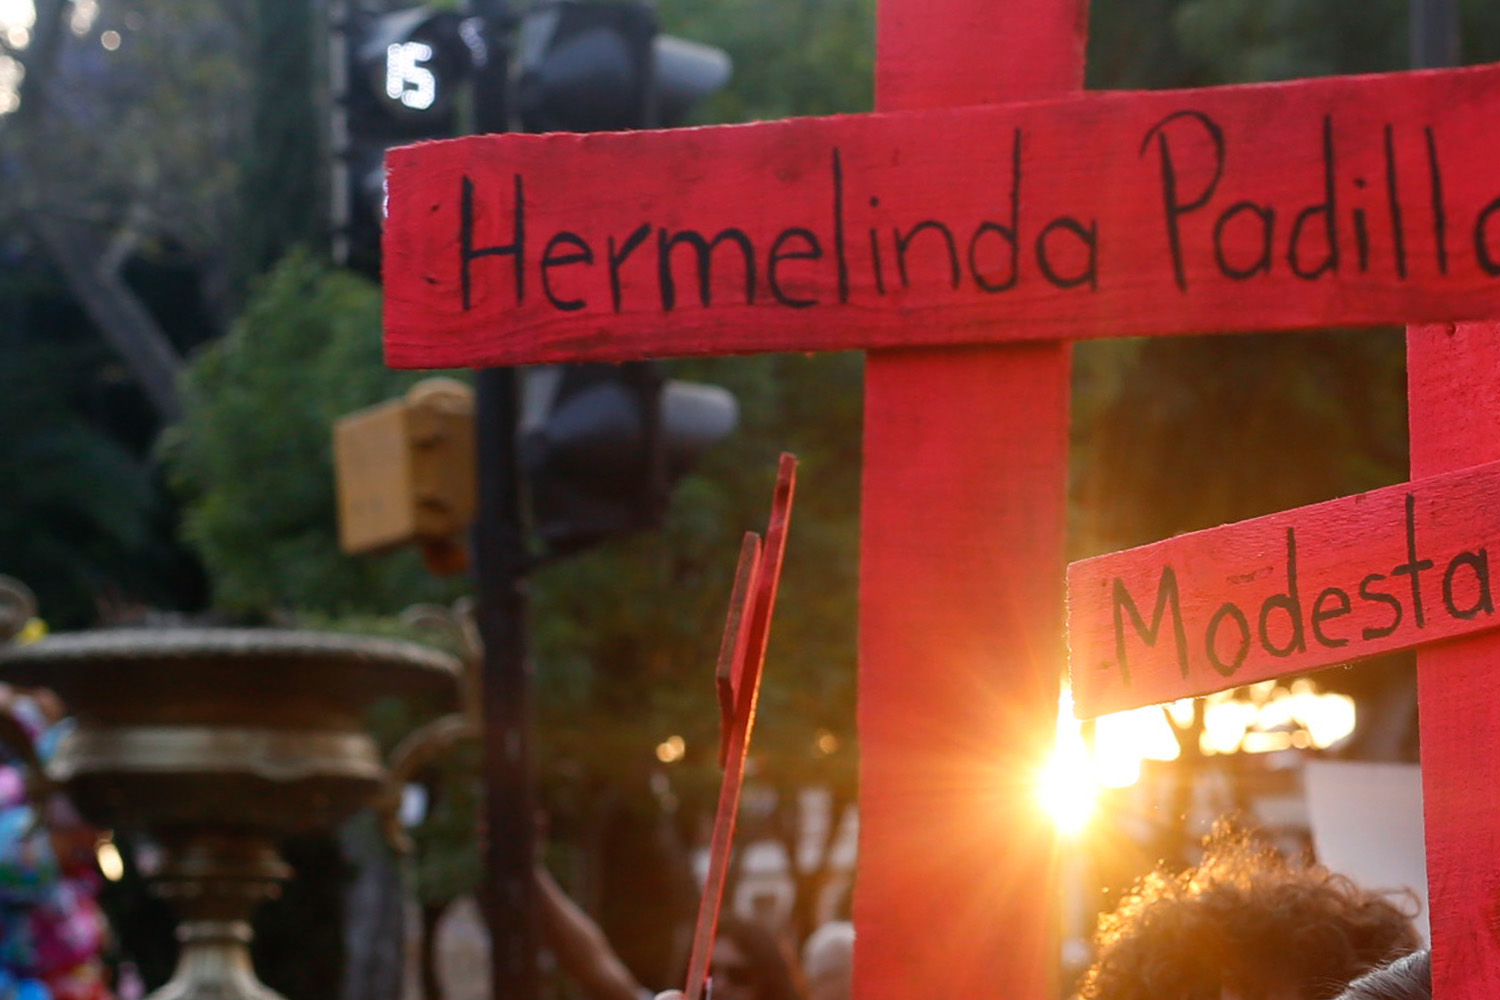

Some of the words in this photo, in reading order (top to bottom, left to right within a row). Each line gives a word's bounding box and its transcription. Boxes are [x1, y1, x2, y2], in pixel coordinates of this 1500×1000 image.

[386, 41, 435, 110] 15
[459, 127, 1100, 314] Hermelinda
[1111, 491, 1496, 688] Modesta
